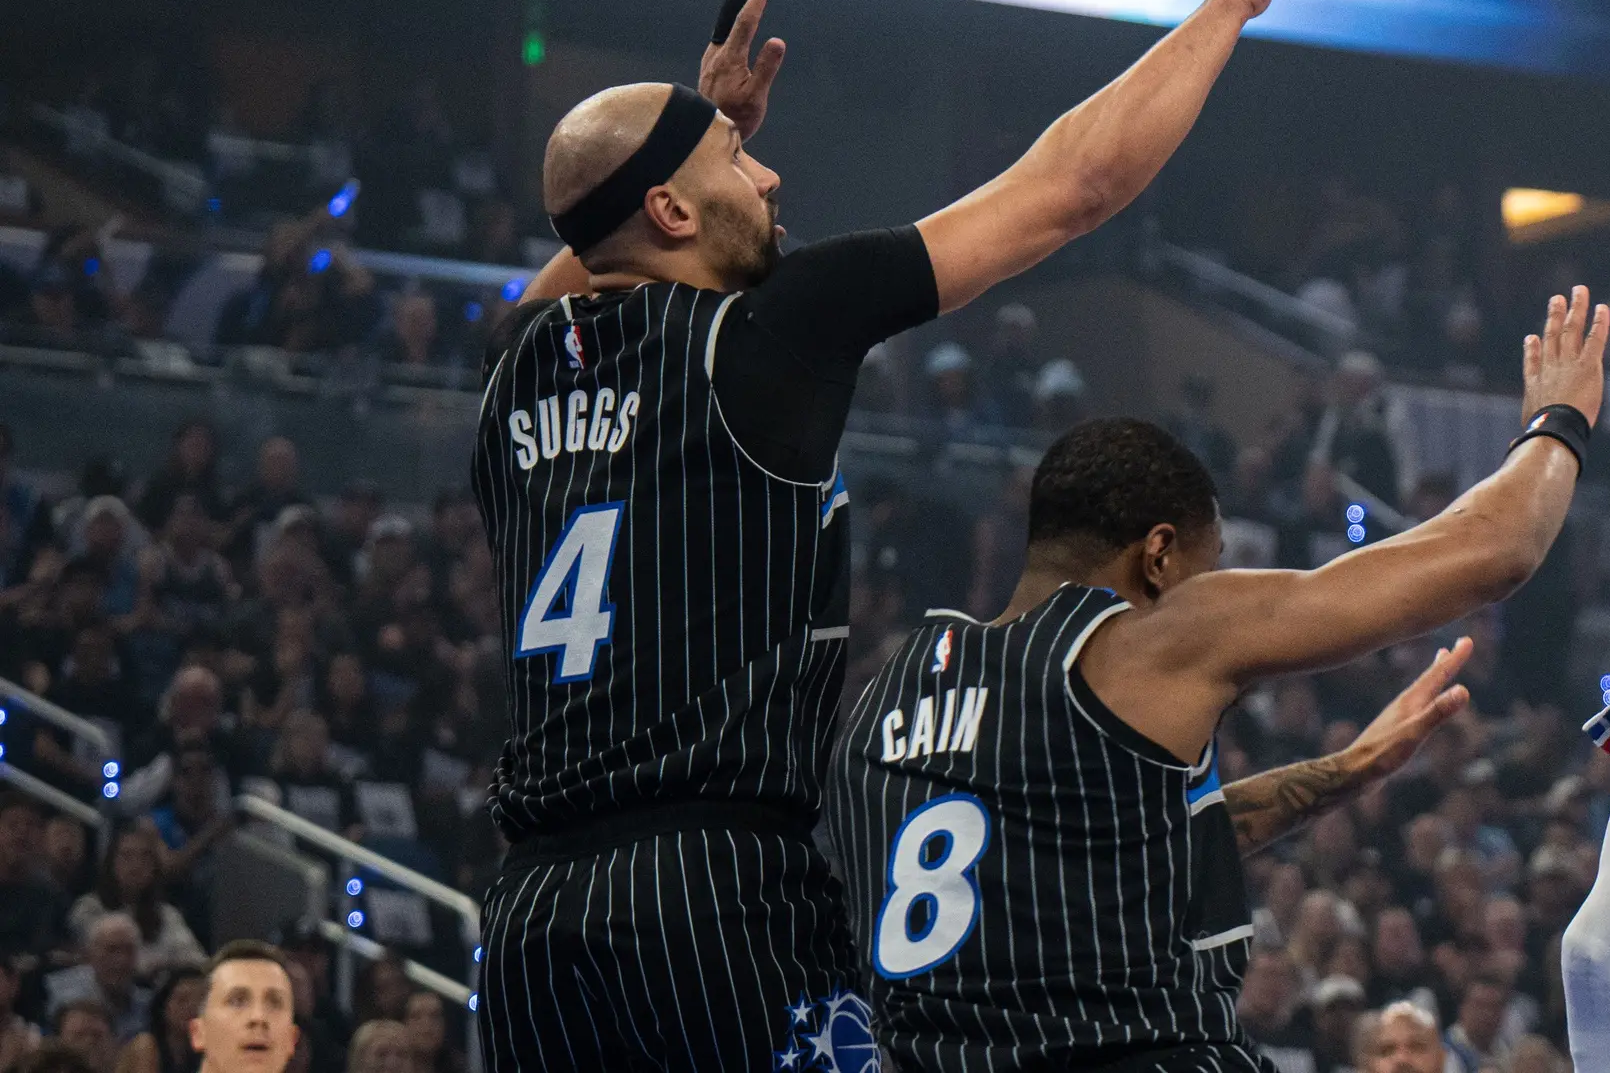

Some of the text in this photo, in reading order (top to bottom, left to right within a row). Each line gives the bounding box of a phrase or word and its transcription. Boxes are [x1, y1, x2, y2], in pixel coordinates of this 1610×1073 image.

[508, 387, 641, 471] SUGGS
[513, 499, 626, 685] 4
[882, 687, 989, 764] CAIN
[873, 792, 991, 980] 8
